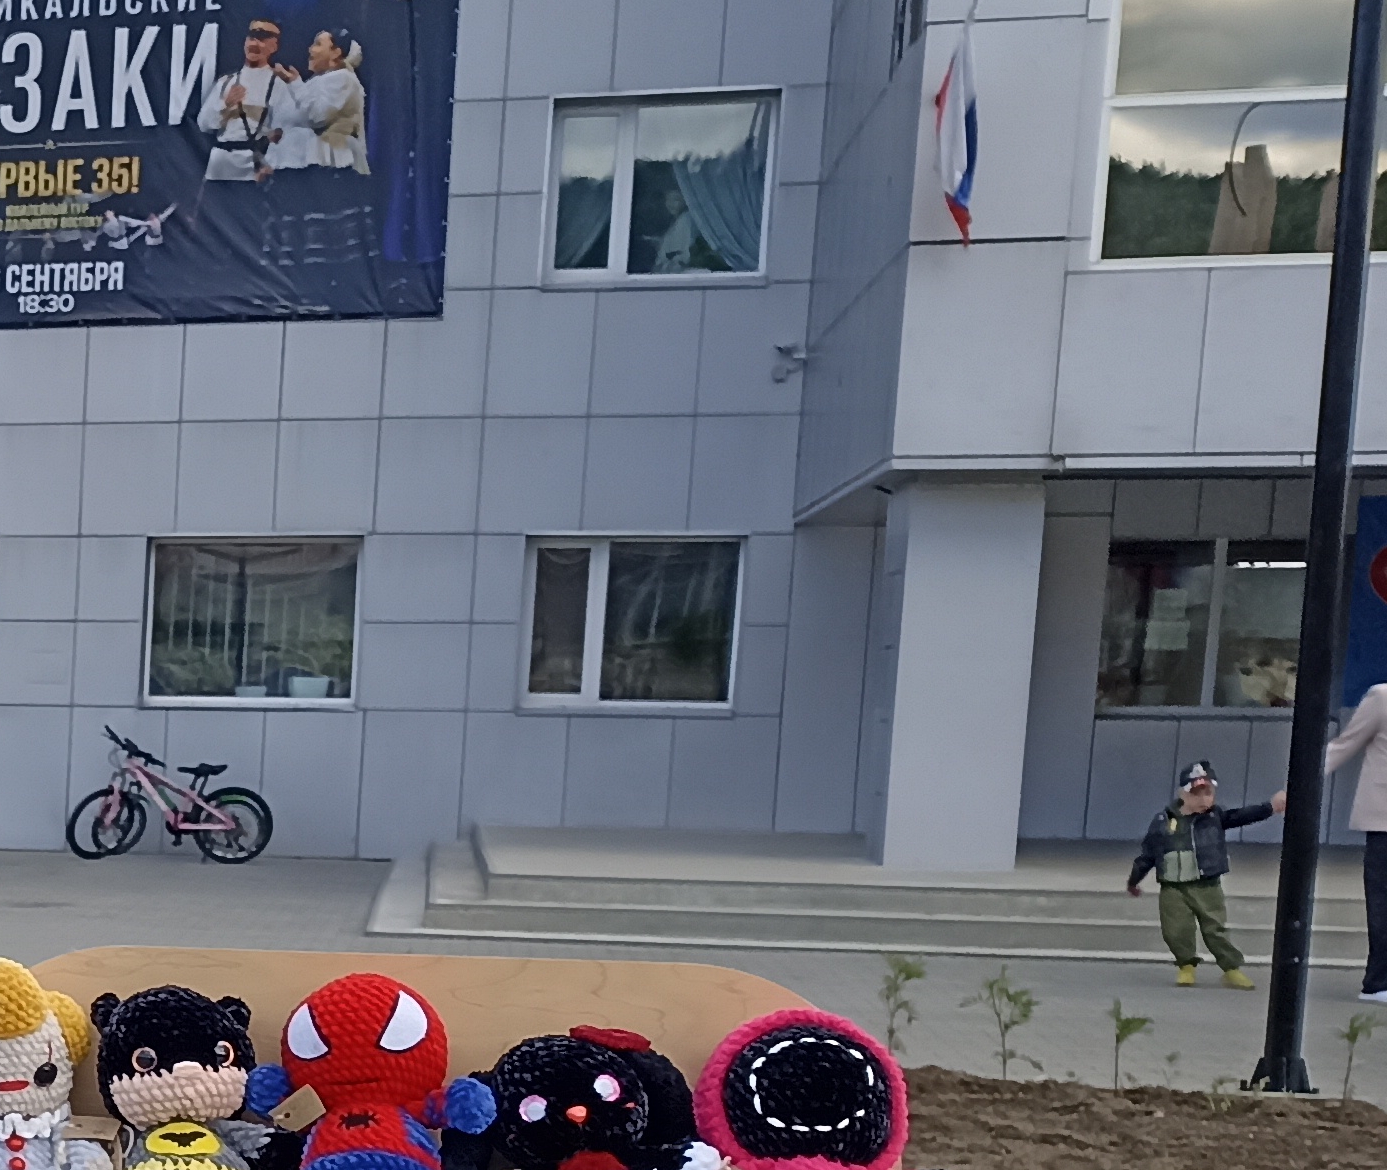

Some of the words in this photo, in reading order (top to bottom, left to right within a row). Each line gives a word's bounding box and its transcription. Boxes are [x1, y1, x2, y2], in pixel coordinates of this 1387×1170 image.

[91, 156, 140, 194] 35!
[5, 261, 125, 294] СЕНТЯБРЯ
[18, 293, 76, 314] 18:30
